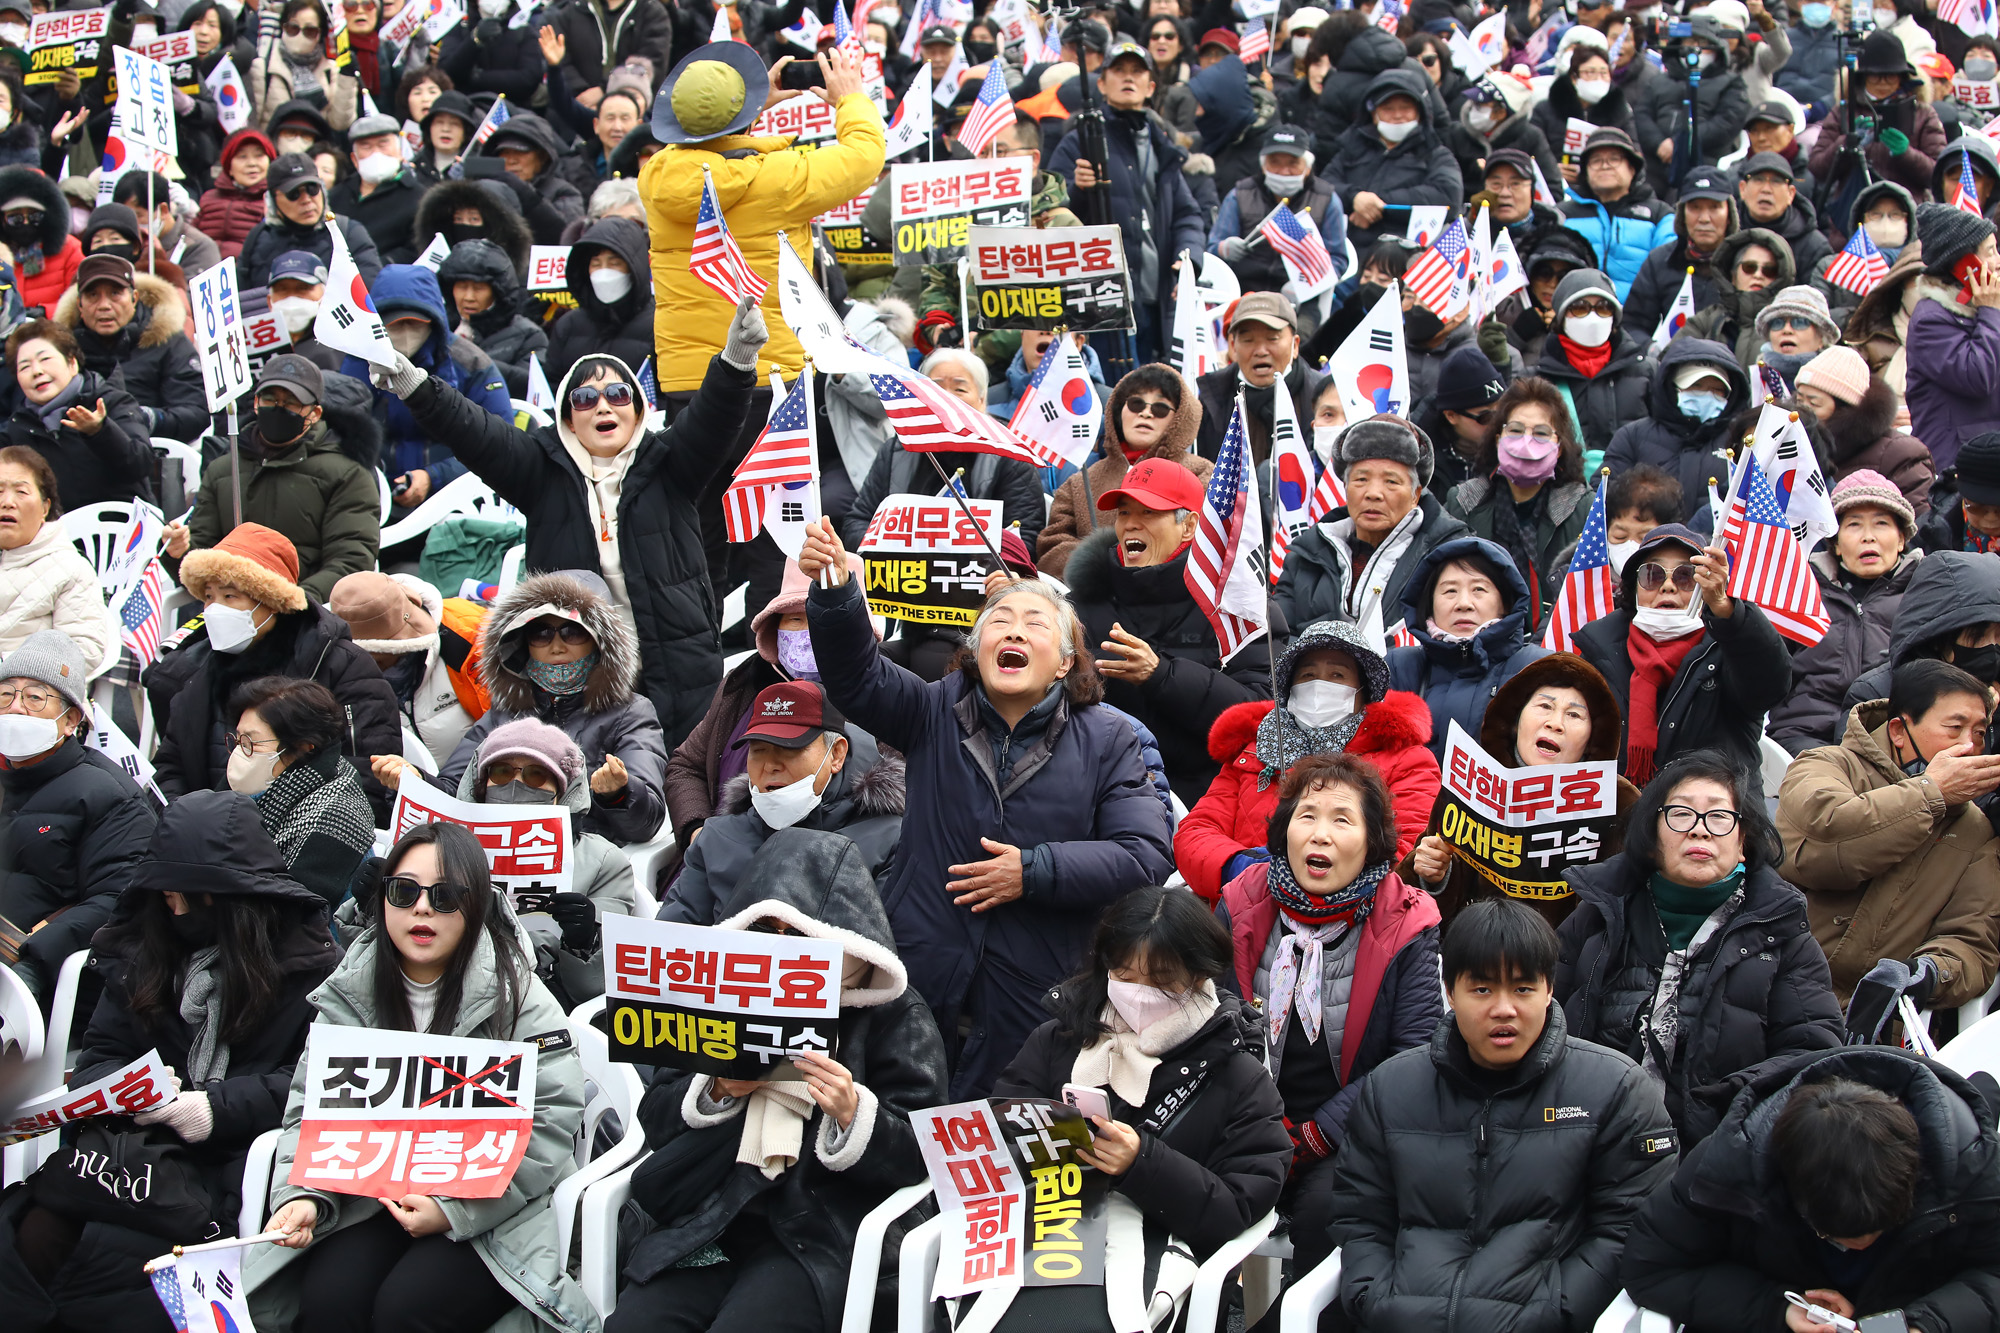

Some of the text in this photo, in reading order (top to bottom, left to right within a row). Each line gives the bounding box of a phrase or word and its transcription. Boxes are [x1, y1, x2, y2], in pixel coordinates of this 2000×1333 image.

[35, 12, 105, 44] 탄핵무효
[32, 40, 100, 71] 이재명 구속
[901, 167, 1022, 215] 탄핵무효
[825, 228, 863, 250] 재명
[897, 215, 974, 253] 이재명
[978, 237, 1115, 280] 탄핵무효
[982, 279, 1124, 318] 이재명 구속
[859, 505, 992, 548] 탄핵무효
[930, 560, 988, 595] 구속
[869, 602, 972, 623] STOP THE STEAL
[1449, 744, 1604, 822] 탄핵무효
[1442, 802, 1601, 869] 이재명 구속
[1490, 871, 1518, 894] THE
[615, 942, 831, 1009] 탄핵무효
[613, 1006, 830, 1065] 이재명 구속
[319, 1054, 524, 1109] 조기대선
[1555, 1106, 1582, 1114] NATIONAL
[1555, 1111, 1590, 1120] GEOGRAPHIC
[303, 1129, 519, 1184] 조기총선
[931, 1110, 1020, 1285] 탄핵무효
[1004, 1102, 1083, 1279] 이재명 구속
